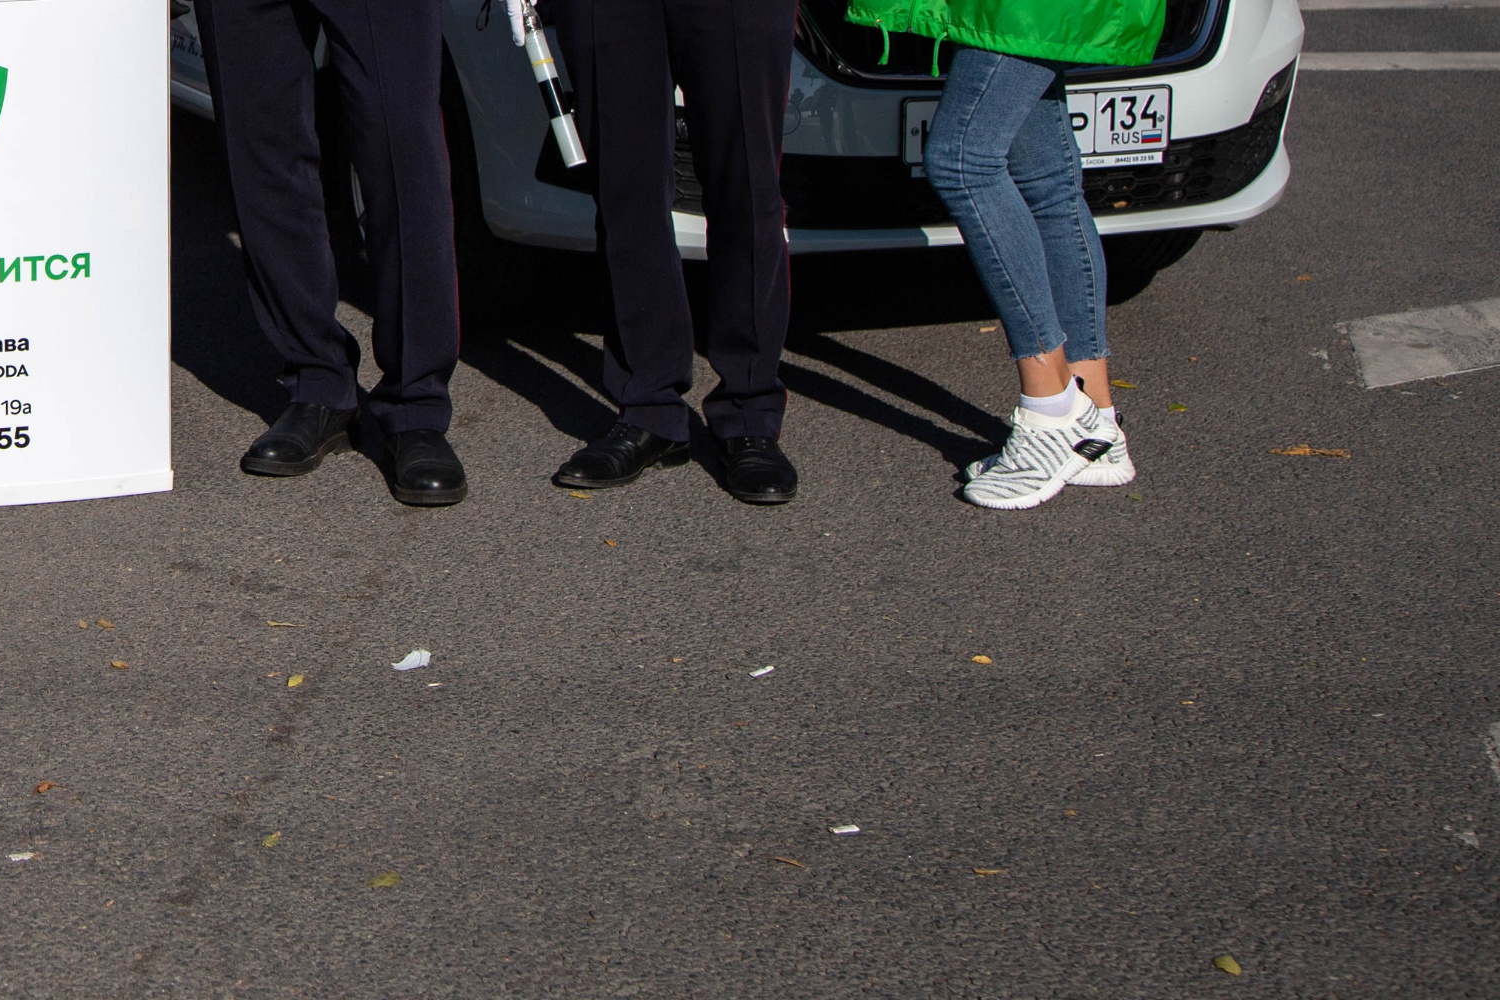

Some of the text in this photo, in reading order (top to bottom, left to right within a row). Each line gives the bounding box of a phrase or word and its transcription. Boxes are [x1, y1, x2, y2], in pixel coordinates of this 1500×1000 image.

[1099, 94, 1158, 132] 134
[1111, 130, 1140, 145] RUS
[1, 399, 32, 416] 19а
